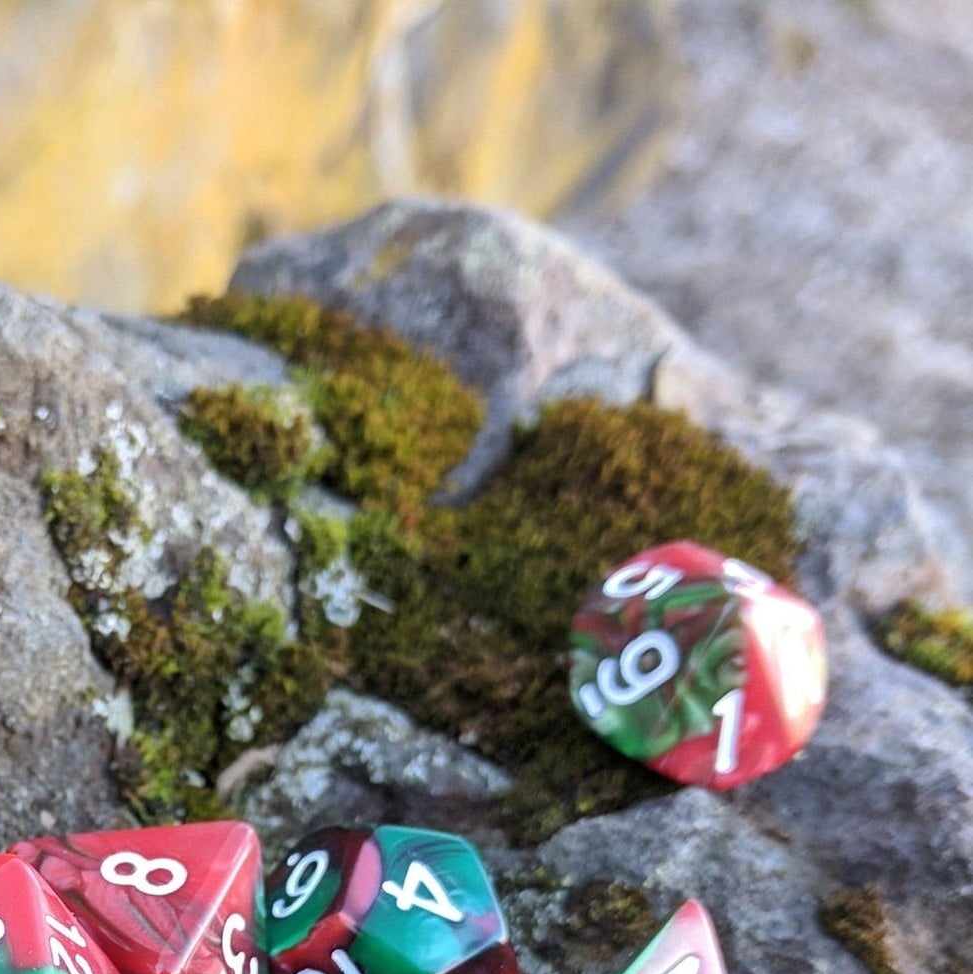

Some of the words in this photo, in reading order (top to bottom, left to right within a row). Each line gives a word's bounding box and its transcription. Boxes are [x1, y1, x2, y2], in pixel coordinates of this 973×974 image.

[602, 561, 684, 600] 5
[712, 688, 744, 774] 1
[100, 851, 188, 896] 8
[381, 860, 464, 923] 4
